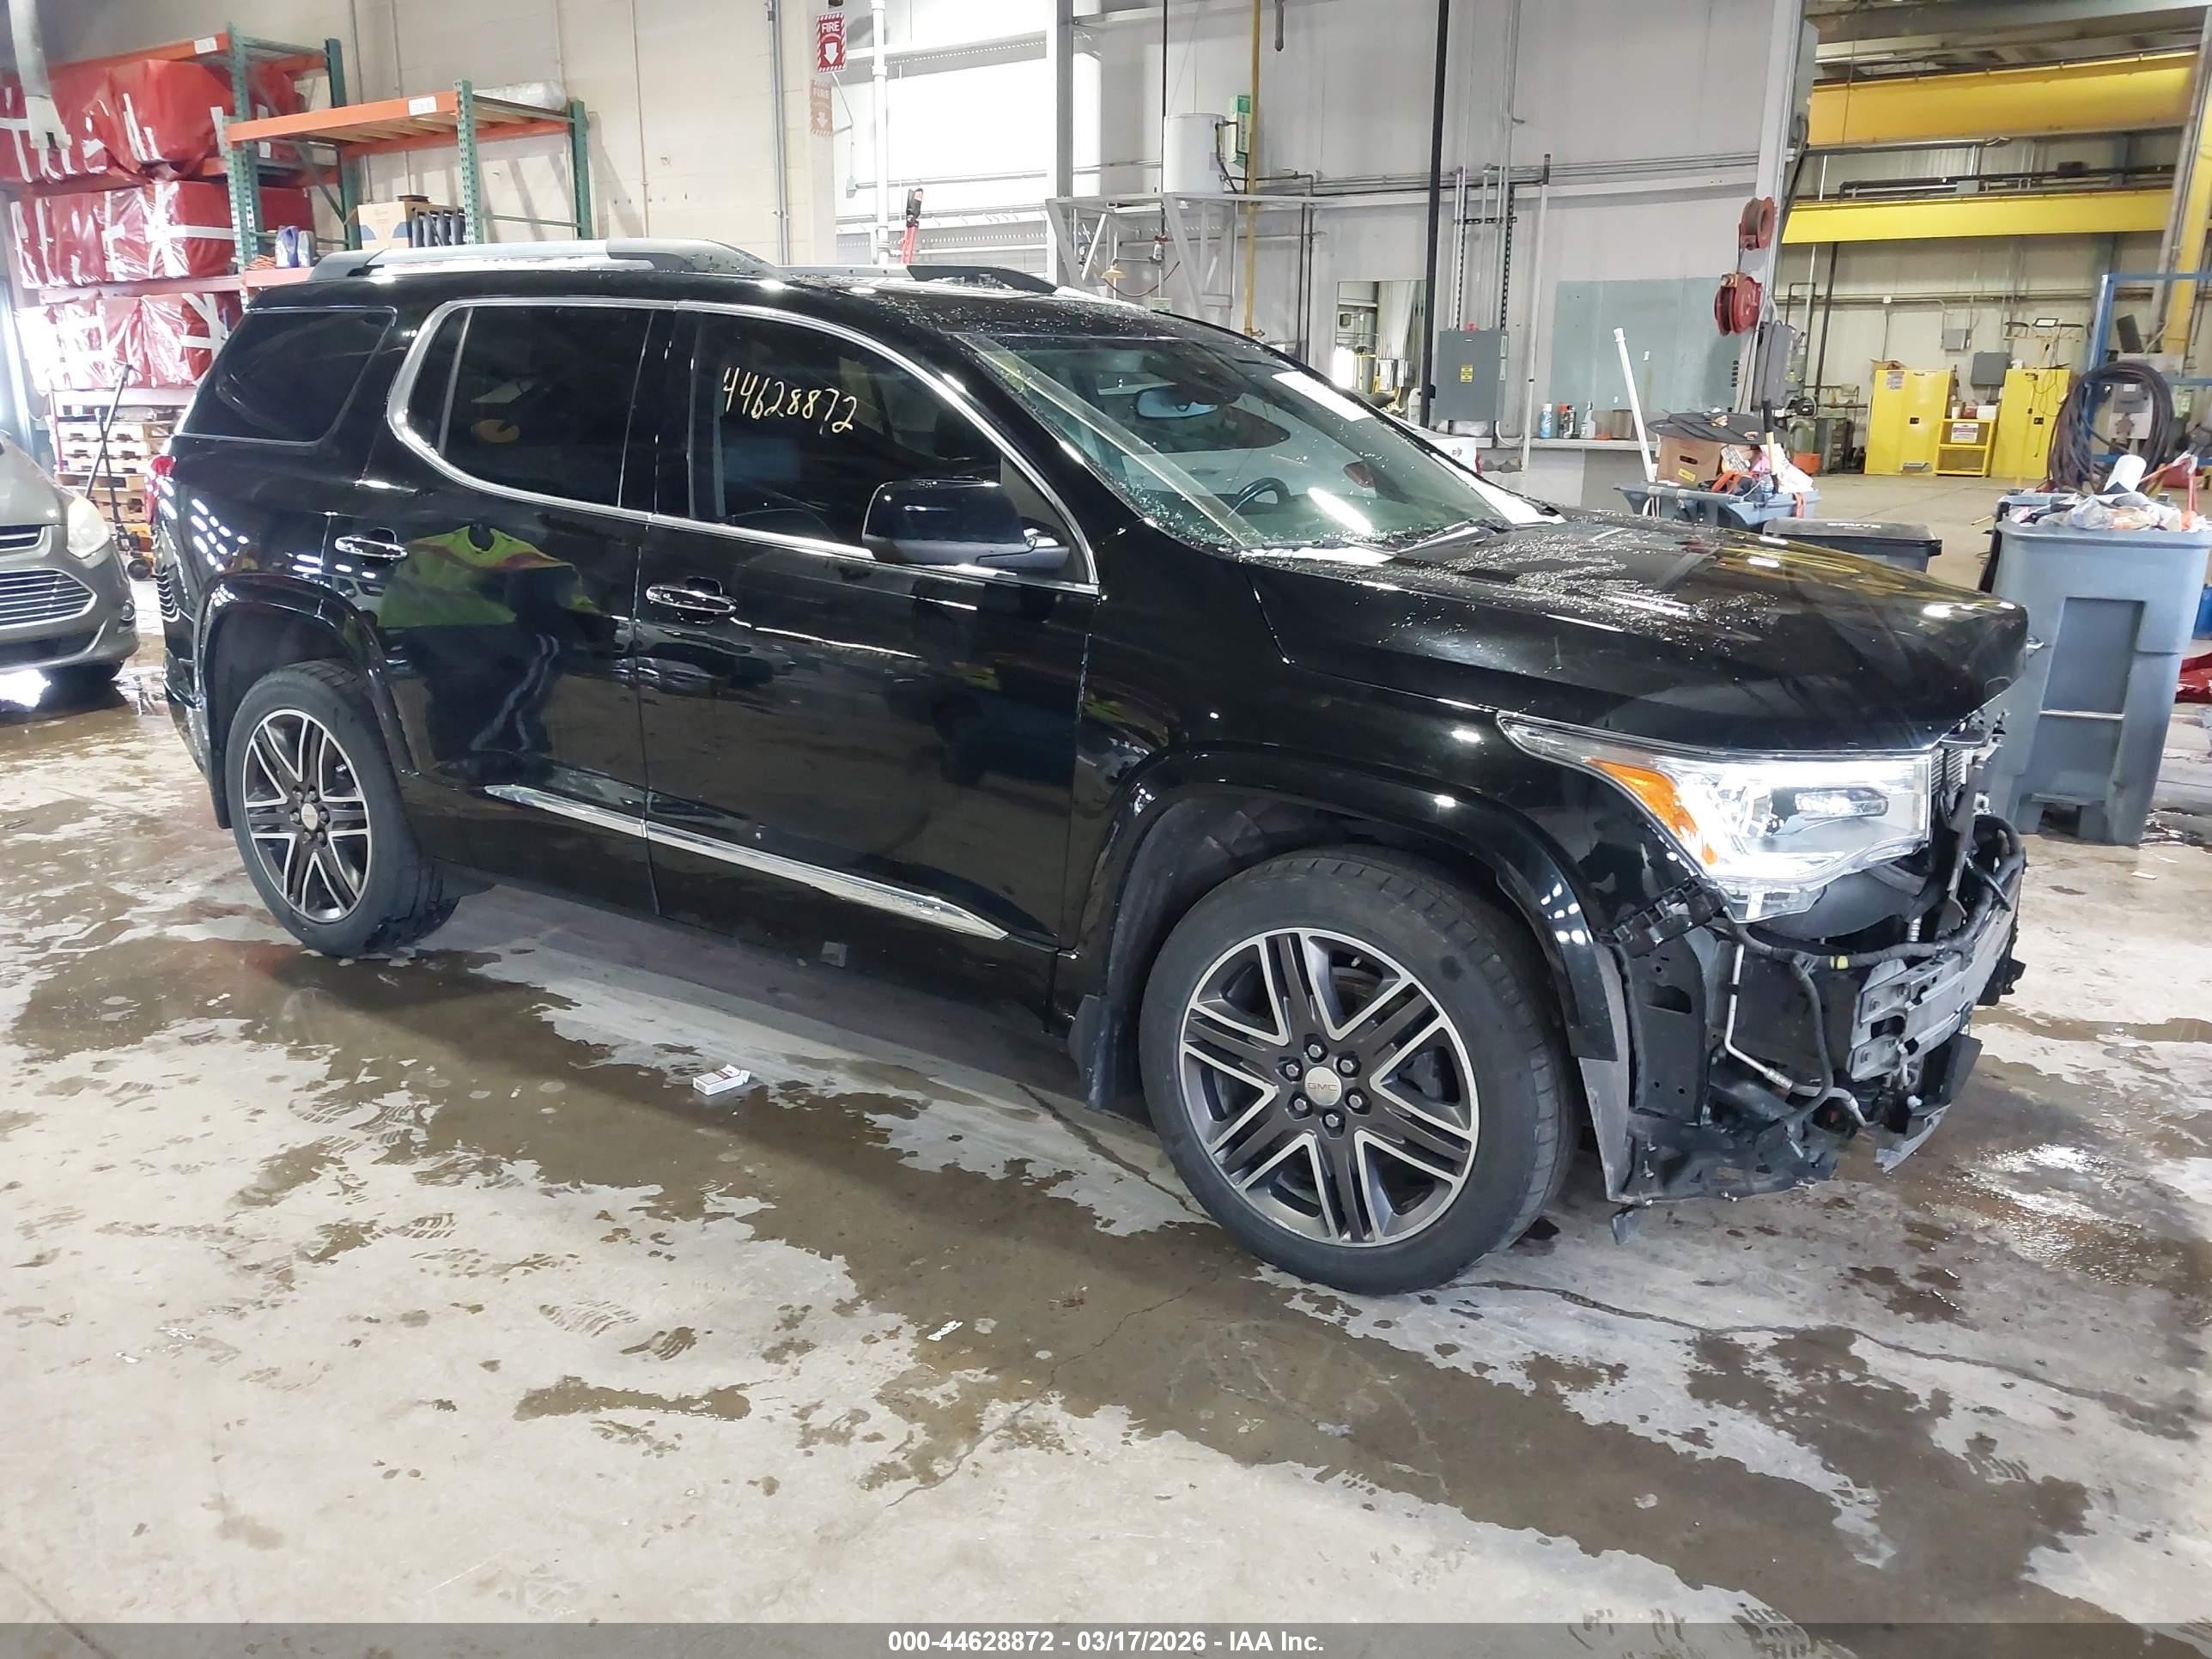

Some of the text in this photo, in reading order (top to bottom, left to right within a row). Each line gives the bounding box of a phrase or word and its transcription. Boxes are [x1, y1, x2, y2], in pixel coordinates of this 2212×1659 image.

[821, 21, 841, 33] FIRE
[722, 367, 857, 434] 44628872
[1307, 1082, 1338, 1091] GMC
